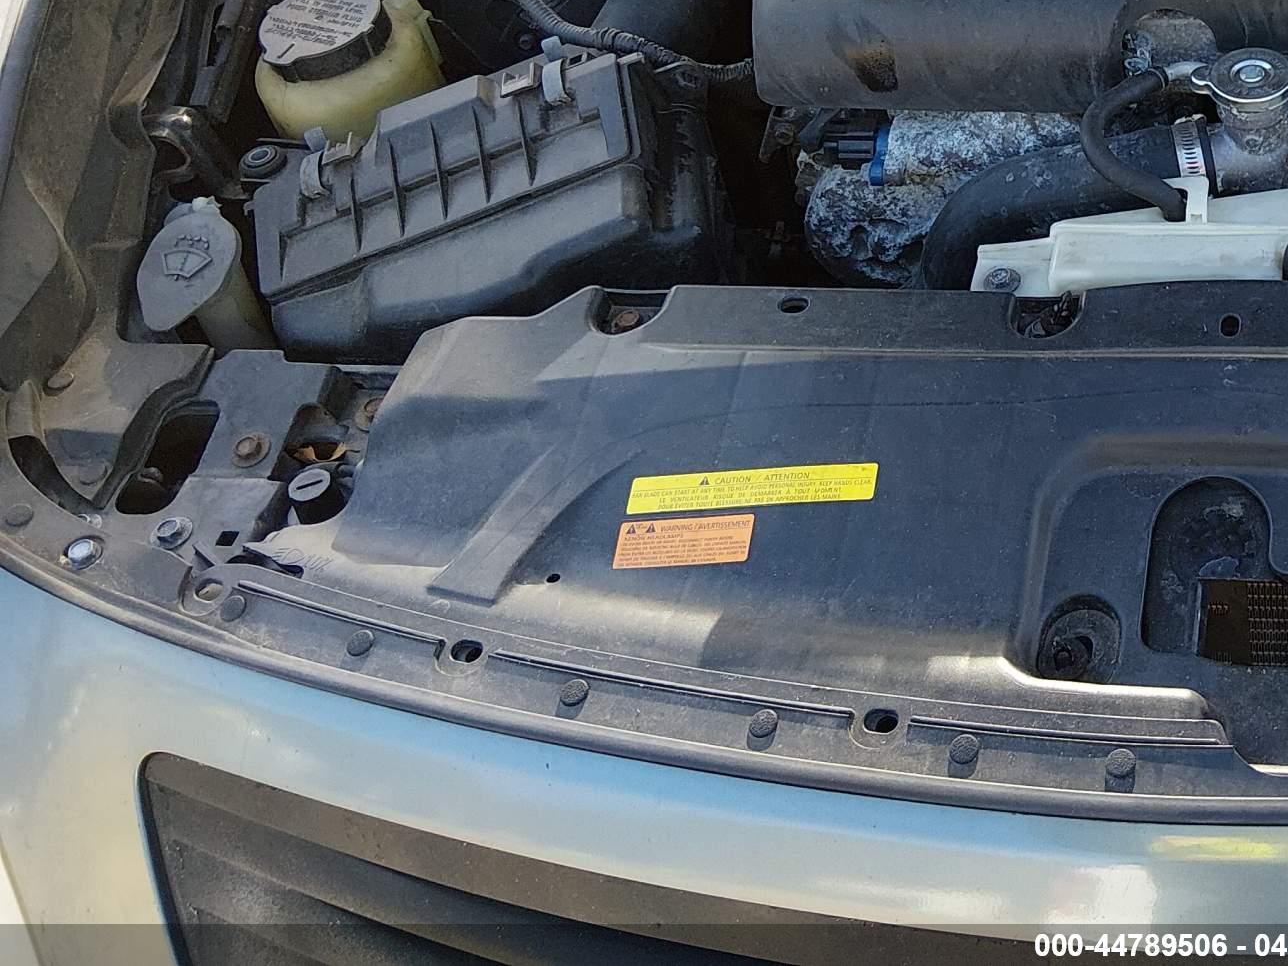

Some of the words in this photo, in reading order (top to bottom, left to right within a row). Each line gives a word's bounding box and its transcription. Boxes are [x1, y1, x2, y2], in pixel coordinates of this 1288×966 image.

[715, 476, 752, 484] CAUTION
[764, 472, 810, 481] ATTENTION
[661, 523, 694, 532] WARNING
[698, 520, 751, 530] AVERTISSEMENT
